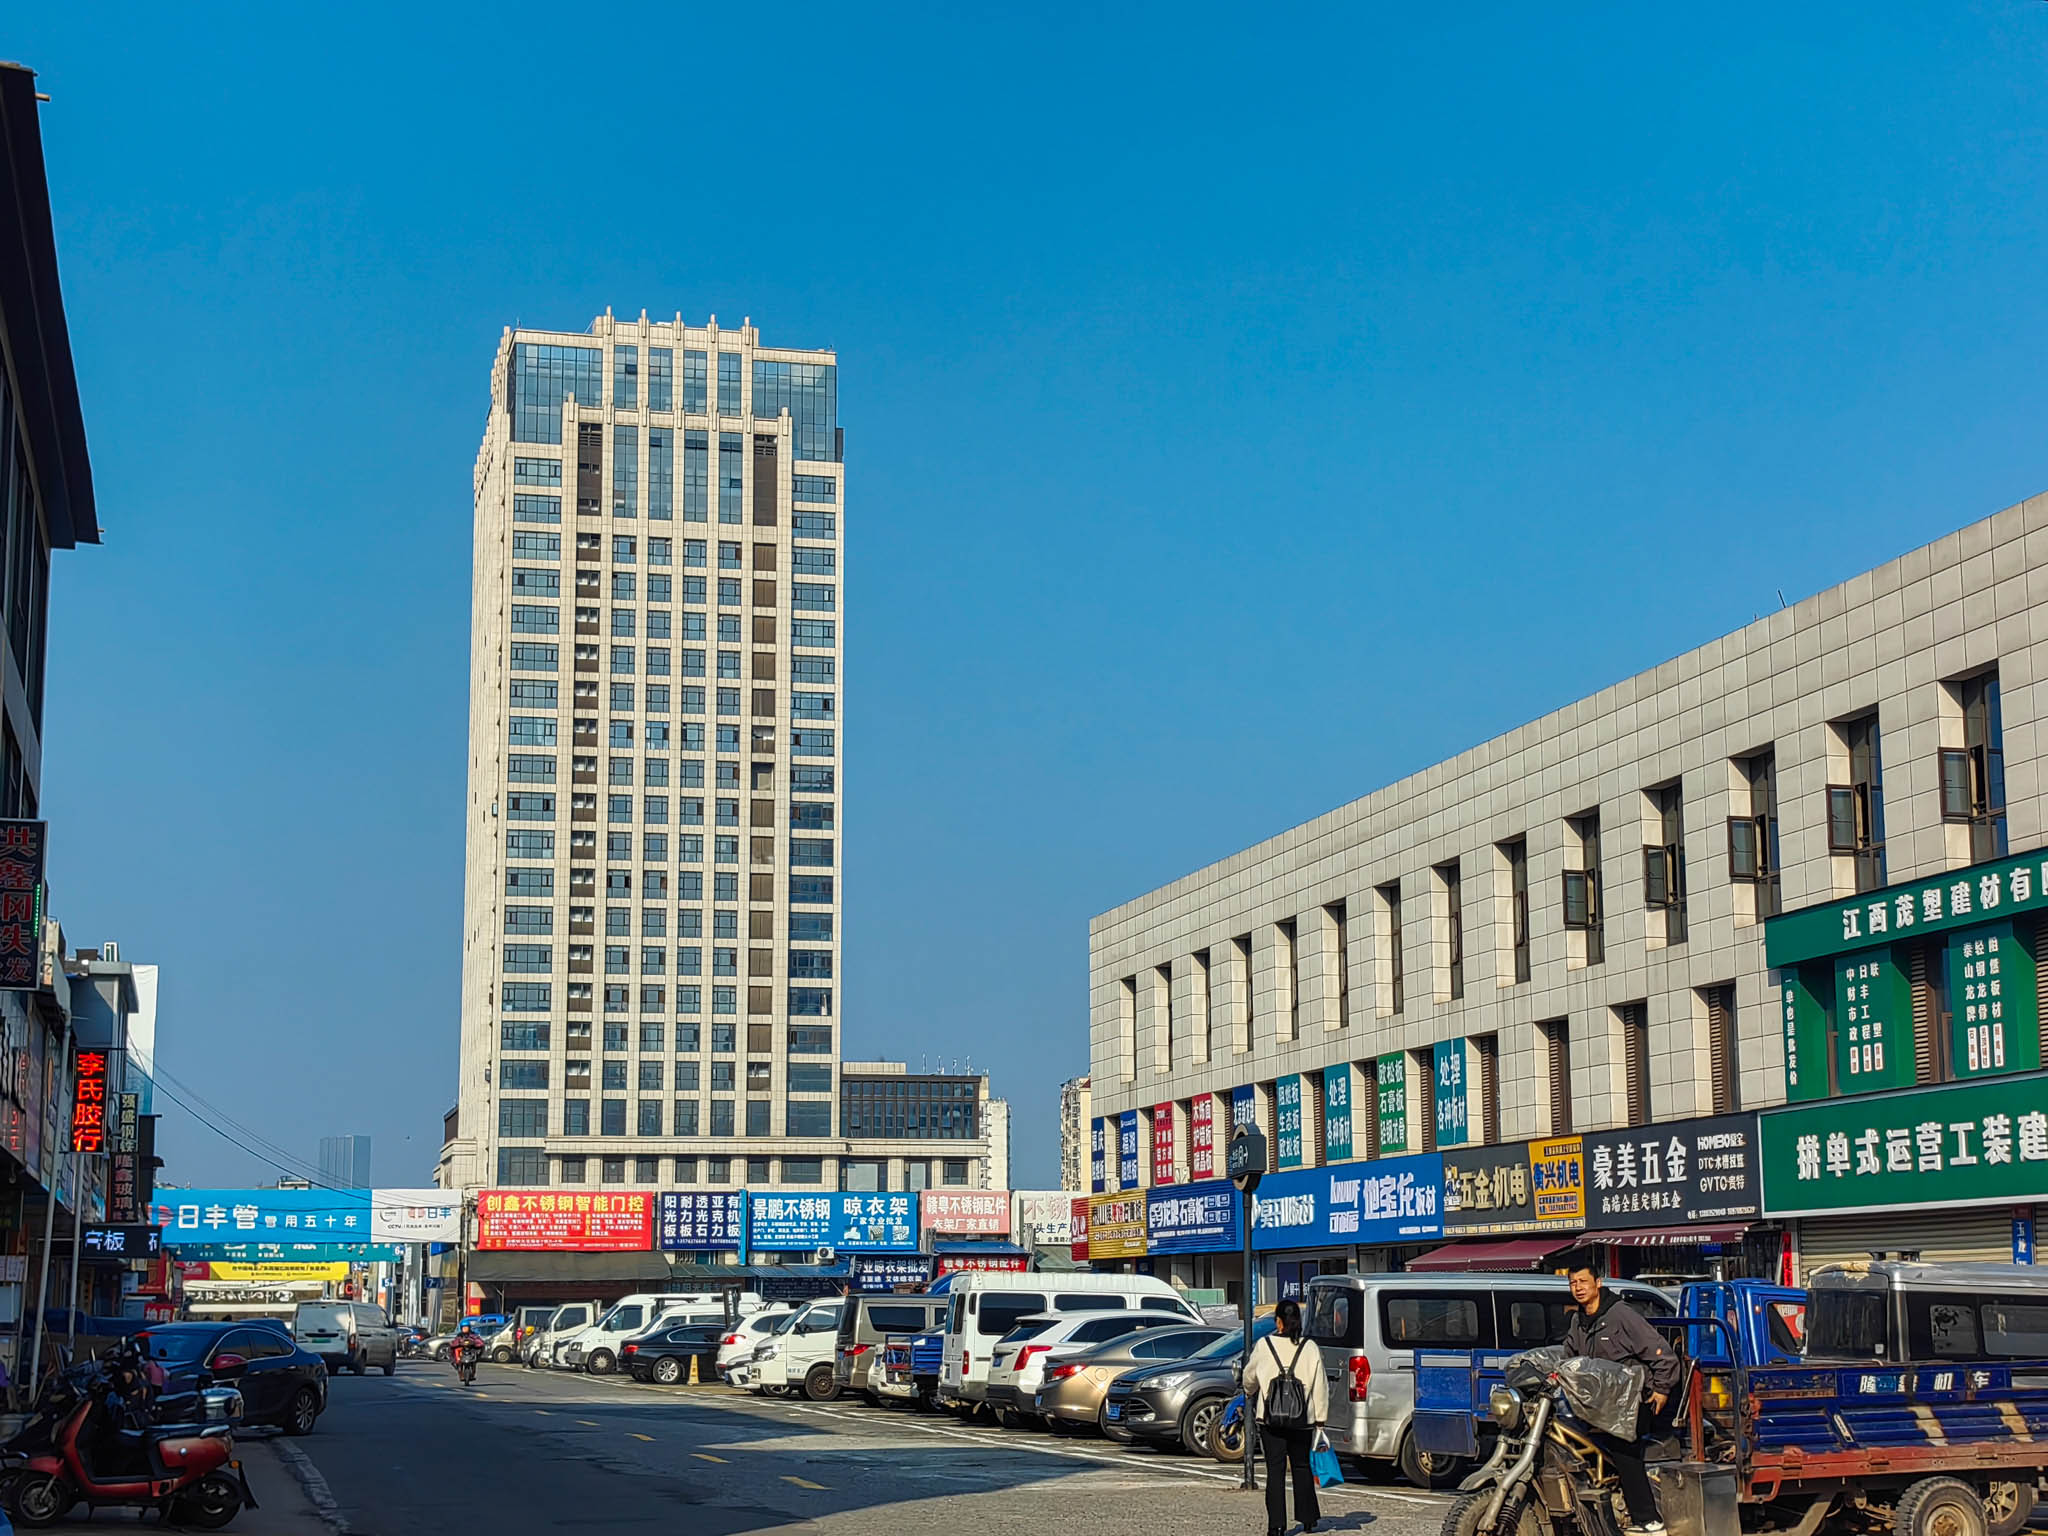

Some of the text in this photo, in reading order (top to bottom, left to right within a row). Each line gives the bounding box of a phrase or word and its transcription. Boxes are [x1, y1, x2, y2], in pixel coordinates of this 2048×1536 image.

[1379, 1060, 1403, 1085] 欧松板
[1440, 1054, 1460, 1086] 处理
[73, 1052, 104, 1151] 李氏胶行
[1329, 1077, 1346, 1106] 处理
[1379, 1088, 1404, 1114] 石膏板
[1438, 1096, 1465, 1130] 各种板材
[1796, 1111, 2048, 1180] 拼单式运营工装建
[1593, 1136, 1687, 1190] 豪美五金
[178, 1205, 258, 1230] 日丰管
[487, 1195, 644, 1212] 创鑫不锈钢智能门控
[664, 1195, 677, 1237] 阳光板
[680, 1195, 692, 1237] 耐力板
[696, 1195, 708, 1237] 透光石
[712, 1195, 724, 1237] 亚克力
[727, 1195, 741, 1237] 有机板
[752, 1198, 831, 1220] 景鹏不锈钢
[843, 1196, 909, 1216] 晾衣架
[926, 1195, 1007, 1216] 赣粤不锈钢配件
[1602, 1190, 1681, 1213] 高端全屋定制五金
